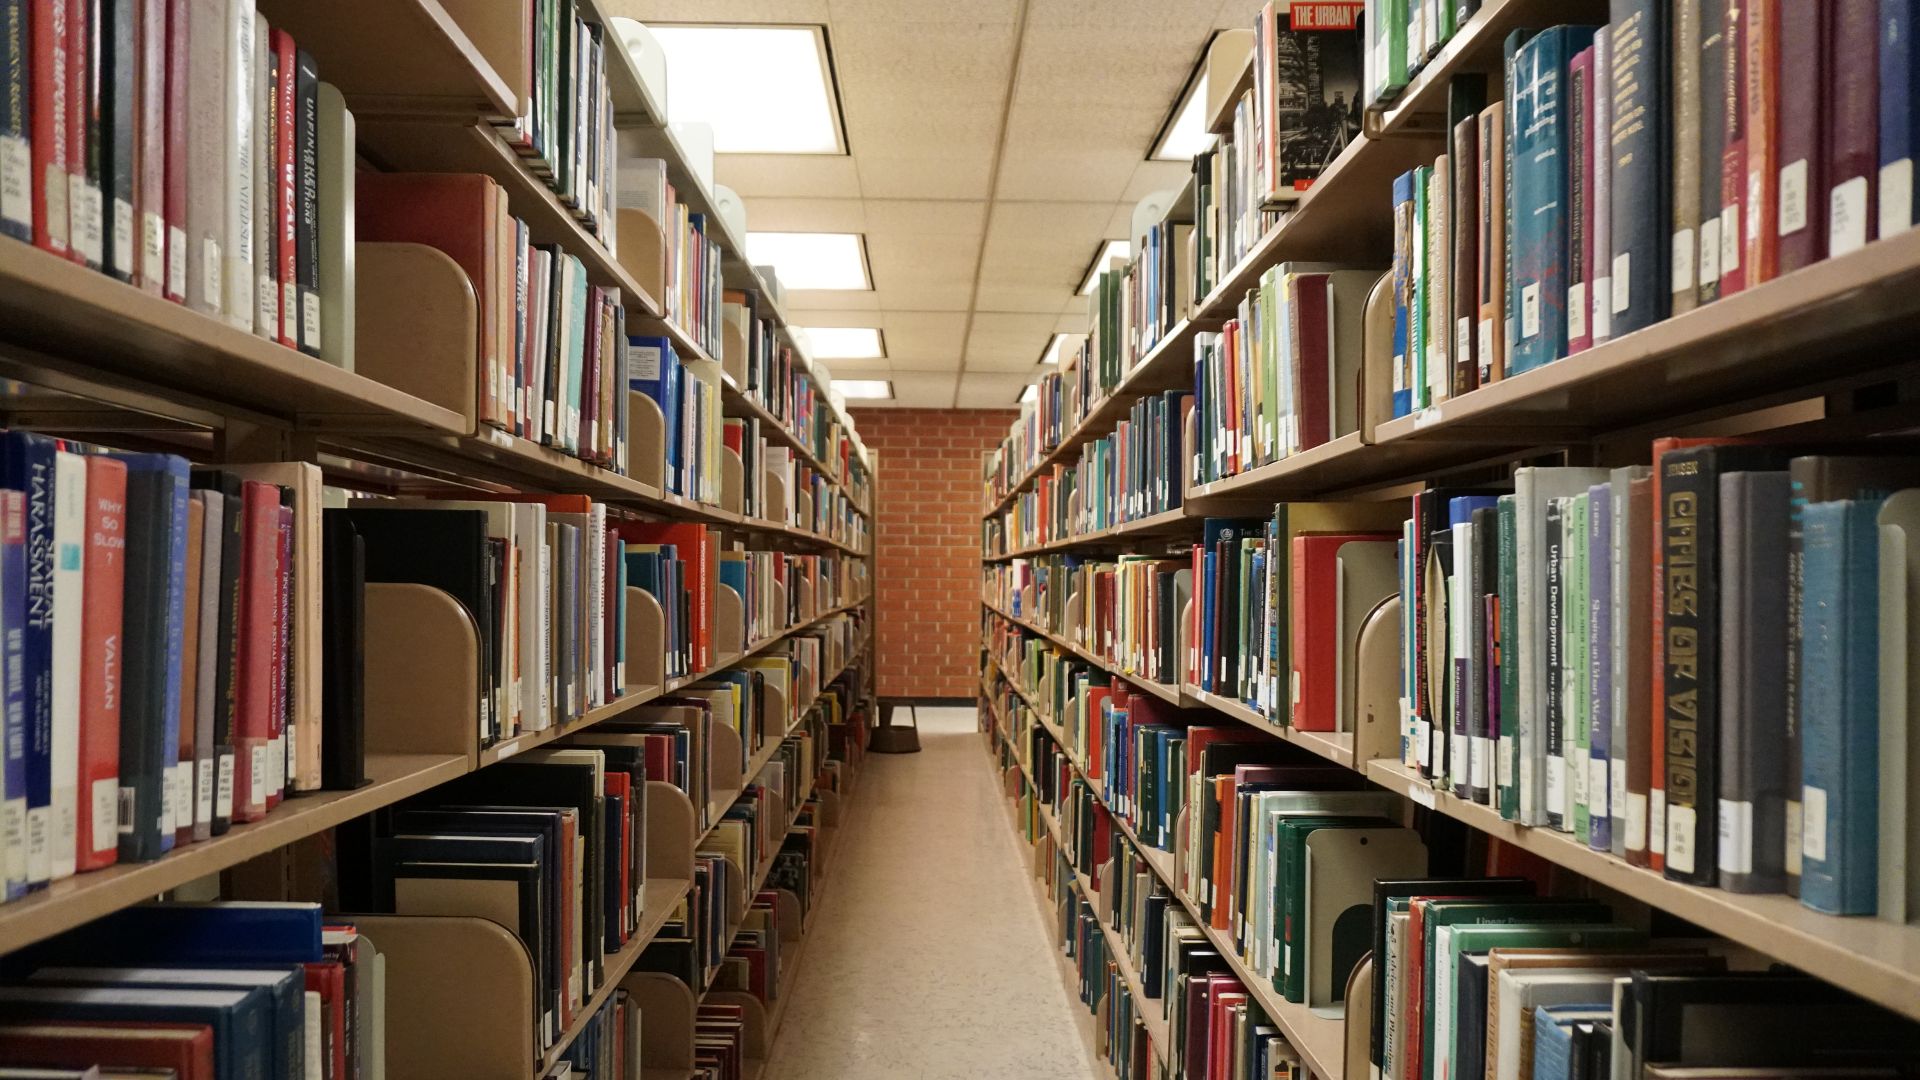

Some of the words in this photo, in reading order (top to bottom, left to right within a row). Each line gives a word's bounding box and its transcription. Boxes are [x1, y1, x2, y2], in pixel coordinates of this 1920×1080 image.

[1295, 5, 1313, 26] THE
[1315, 5, 1351, 26] URBAN
[305, 97, 316, 201] UNFINISHED
[99, 497, 123, 513] WHY
[102, 516, 118, 530] SO
[29, 463, 46, 627] HARASSMENT
[94, 532, 125, 548] SLOW
[1550, 544, 1559, 583] Urban
[1668, 491, 1697, 618] CITIES
[41, 540, 54, 630] SEXUAL
[281, 571, 290, 649] DISCRIMINATION
[1549, 585, 1559, 667] Development
[104, 633, 117, 710] VALIAN
[280, 654, 288, 690] AGAINST
[1667, 627, 1697, 681] OF
[279, 696, 287, 736] WOMEN
[1390, 950, 1398, 992] Advice
[1388, 994, 1397, 1017] and
[1386, 1019, 1396, 1072] Planning
